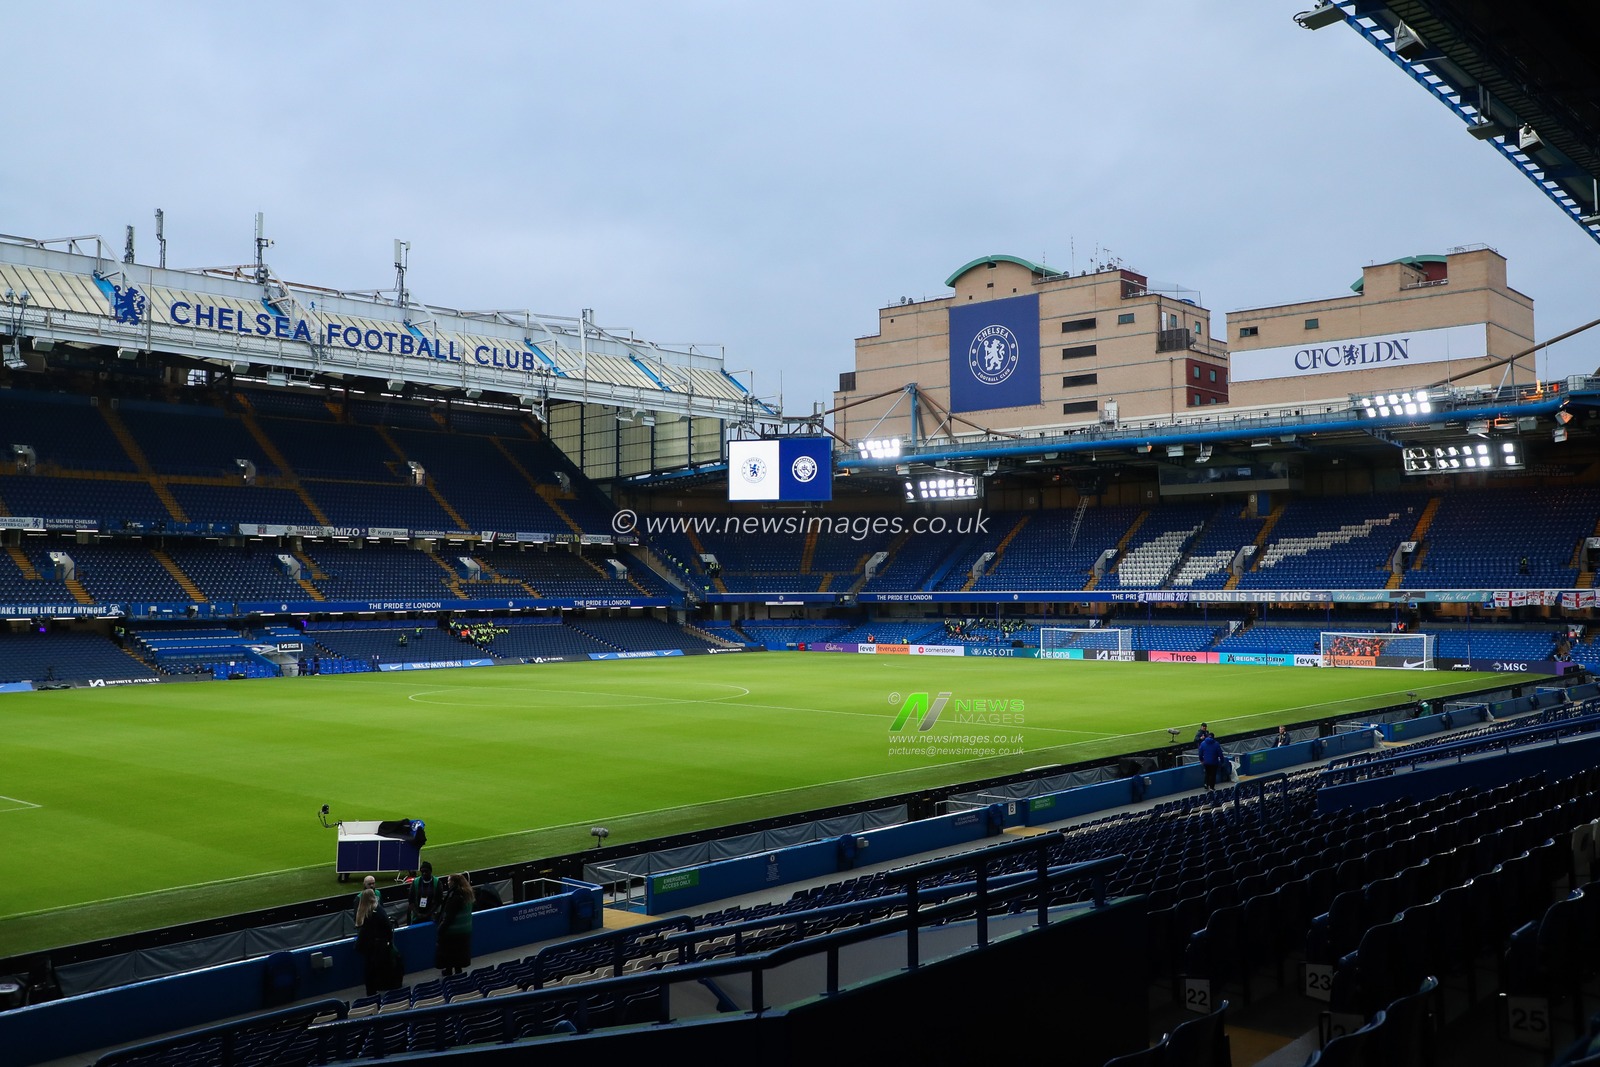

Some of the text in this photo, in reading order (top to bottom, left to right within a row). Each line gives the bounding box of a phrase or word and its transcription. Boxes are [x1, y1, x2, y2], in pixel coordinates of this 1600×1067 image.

[170, 301, 535, 371] CHELSEA FOOTBALL CLUB
[977, 327, 1009, 342] CHELSEA
[1294, 338, 1410, 370] CFC LDN
[977, 368, 1010, 382] FOOTBALL CLUB
[335, 528, 360, 536] MIZO
[1146, 593, 1188, 601] TAMBLING 202
[1199, 592, 1311, 601] BORN IS THE KING
[1337, 592, 1355, 600] Peter
[18, 606, 38, 614] THEM
[40, 606, 56, 614] LIKE
[58, 606, 71, 614] RAY
[73, 606, 107, 614] ANYMORE
[877, 645, 909, 653] feverup.com
[982, 648, 1014, 656] ASCOTT
[1170, 653, 1197, 662] Three
[1503, 663, 1527, 671] MSC
[1010, 804, 1014, 813] 6
[663, 874, 690, 884] EMERGENCY
[662, 881, 680, 890] ACCESS
[534, 904, 552, 912] OFFENCE
[1309, 972, 1331, 990] 23
[1187, 988, 1208, 1006] 22
[1512, 1008, 1546, 1032] 25
